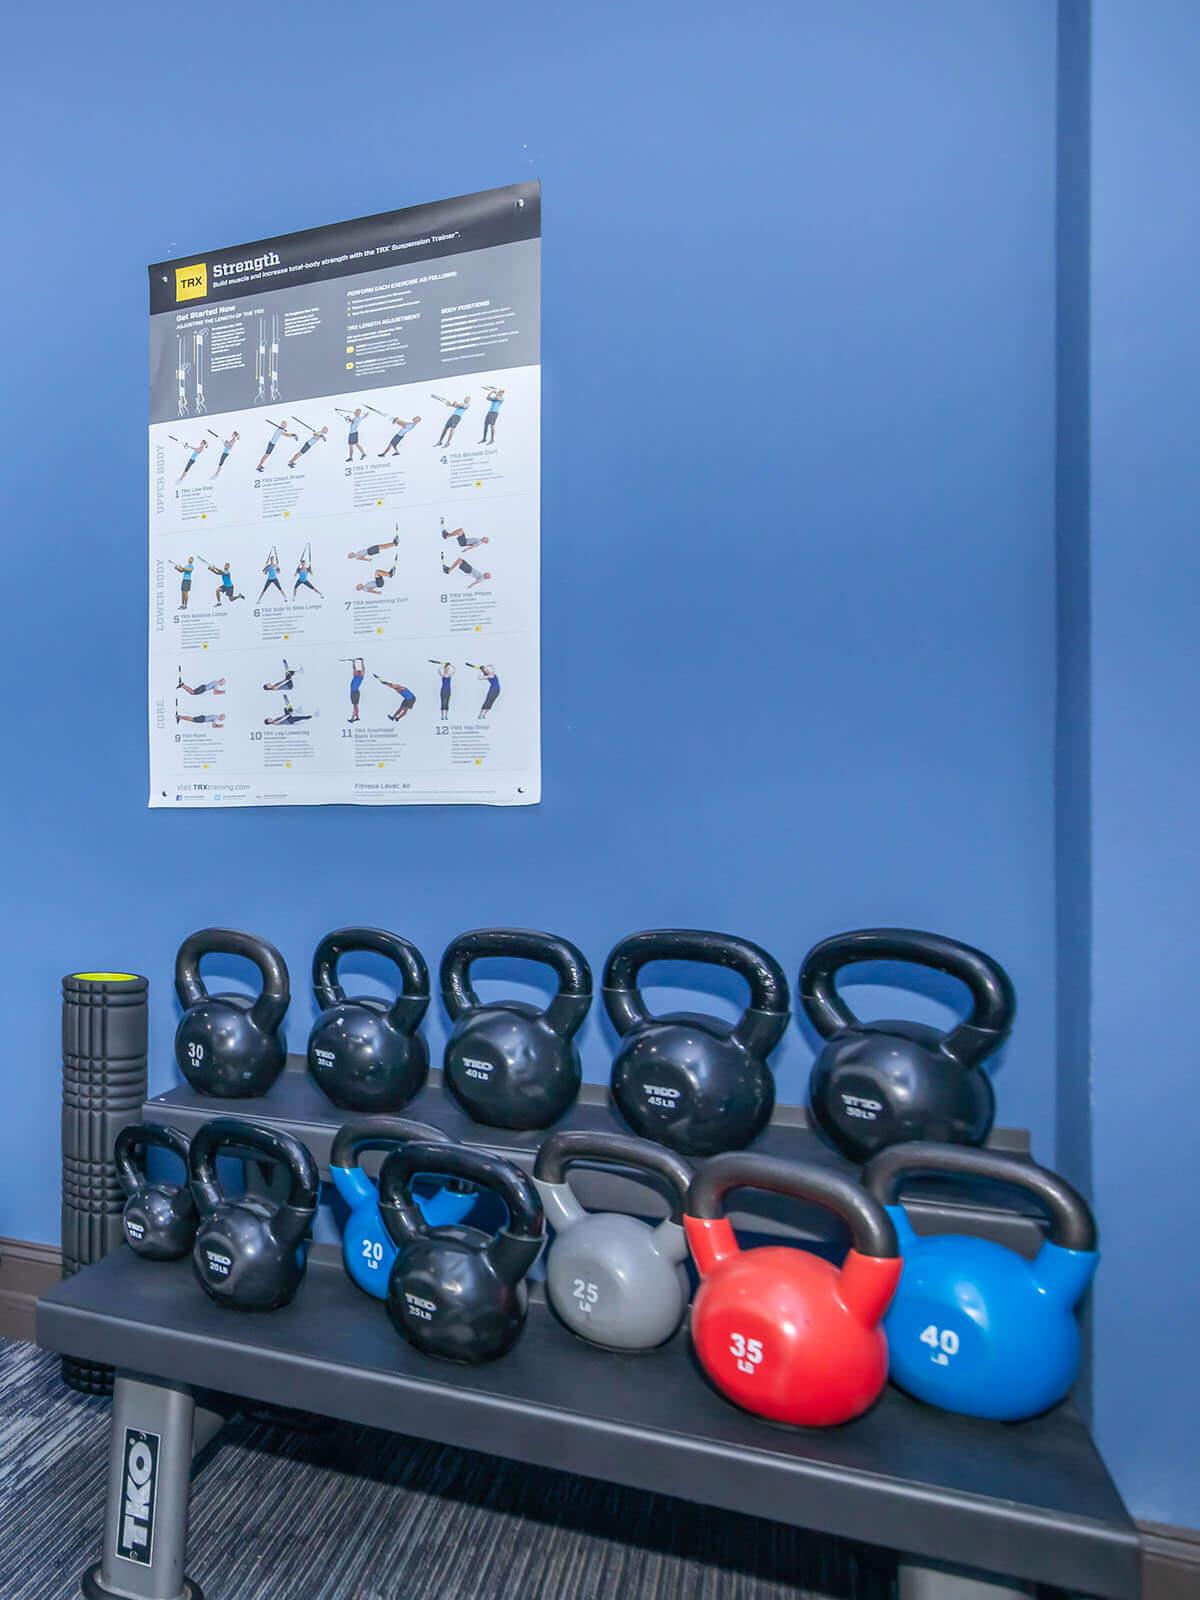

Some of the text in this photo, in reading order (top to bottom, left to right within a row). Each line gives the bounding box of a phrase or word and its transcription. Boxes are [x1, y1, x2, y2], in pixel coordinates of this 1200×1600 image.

[212, 280, 228, 288] Build
[228, 276, 250, 285] muscle
[262, 268, 288, 278] increase
[289, 261, 320, 272] total-body
[322, 254, 348, 266] strength
[392, 238, 430, 250] Suspension
[213, 252, 280, 278] Strength
[180, 277, 202, 288] TRX
[176, 305, 236, 322] Get Started Now
[440, 455, 448, 464] 4
[344, 468, 352, 476] 3
[156, 444, 164, 514] UPPER BODY
[254, 480, 261, 488] 2
[175, 490, 180, 498] 1
[156, 558, 164, 632] LOWER BODY
[440, 594, 448, 603] 8
[344, 602, 352, 610] 7
[254, 608, 260, 618] 6
[174, 614, 180, 624] 5
[250, 731, 262, 740] 10
[342, 728, 352, 738] 11
[435, 725, 449, 736] 12
[174, 734, 182, 742] 9
[193, 784, 250, 792] TRXtraining.com
[188, 1042, 204, 1060] 30
[192, 1060, 200, 1068] LB
[362, 1239, 383, 1261] 20
[368, 1260, 378, 1270] LB
[573, 1279, 598, 1303] 25
[579, 1302, 592, 1312] LB
[920, 1324, 960, 1356] 40
[730, 1332, 763, 1364] 35
[930, 1354, 949, 1366] LB
[737, 1358, 754, 1375] LB
[122, 1442, 152, 1550] TKO
